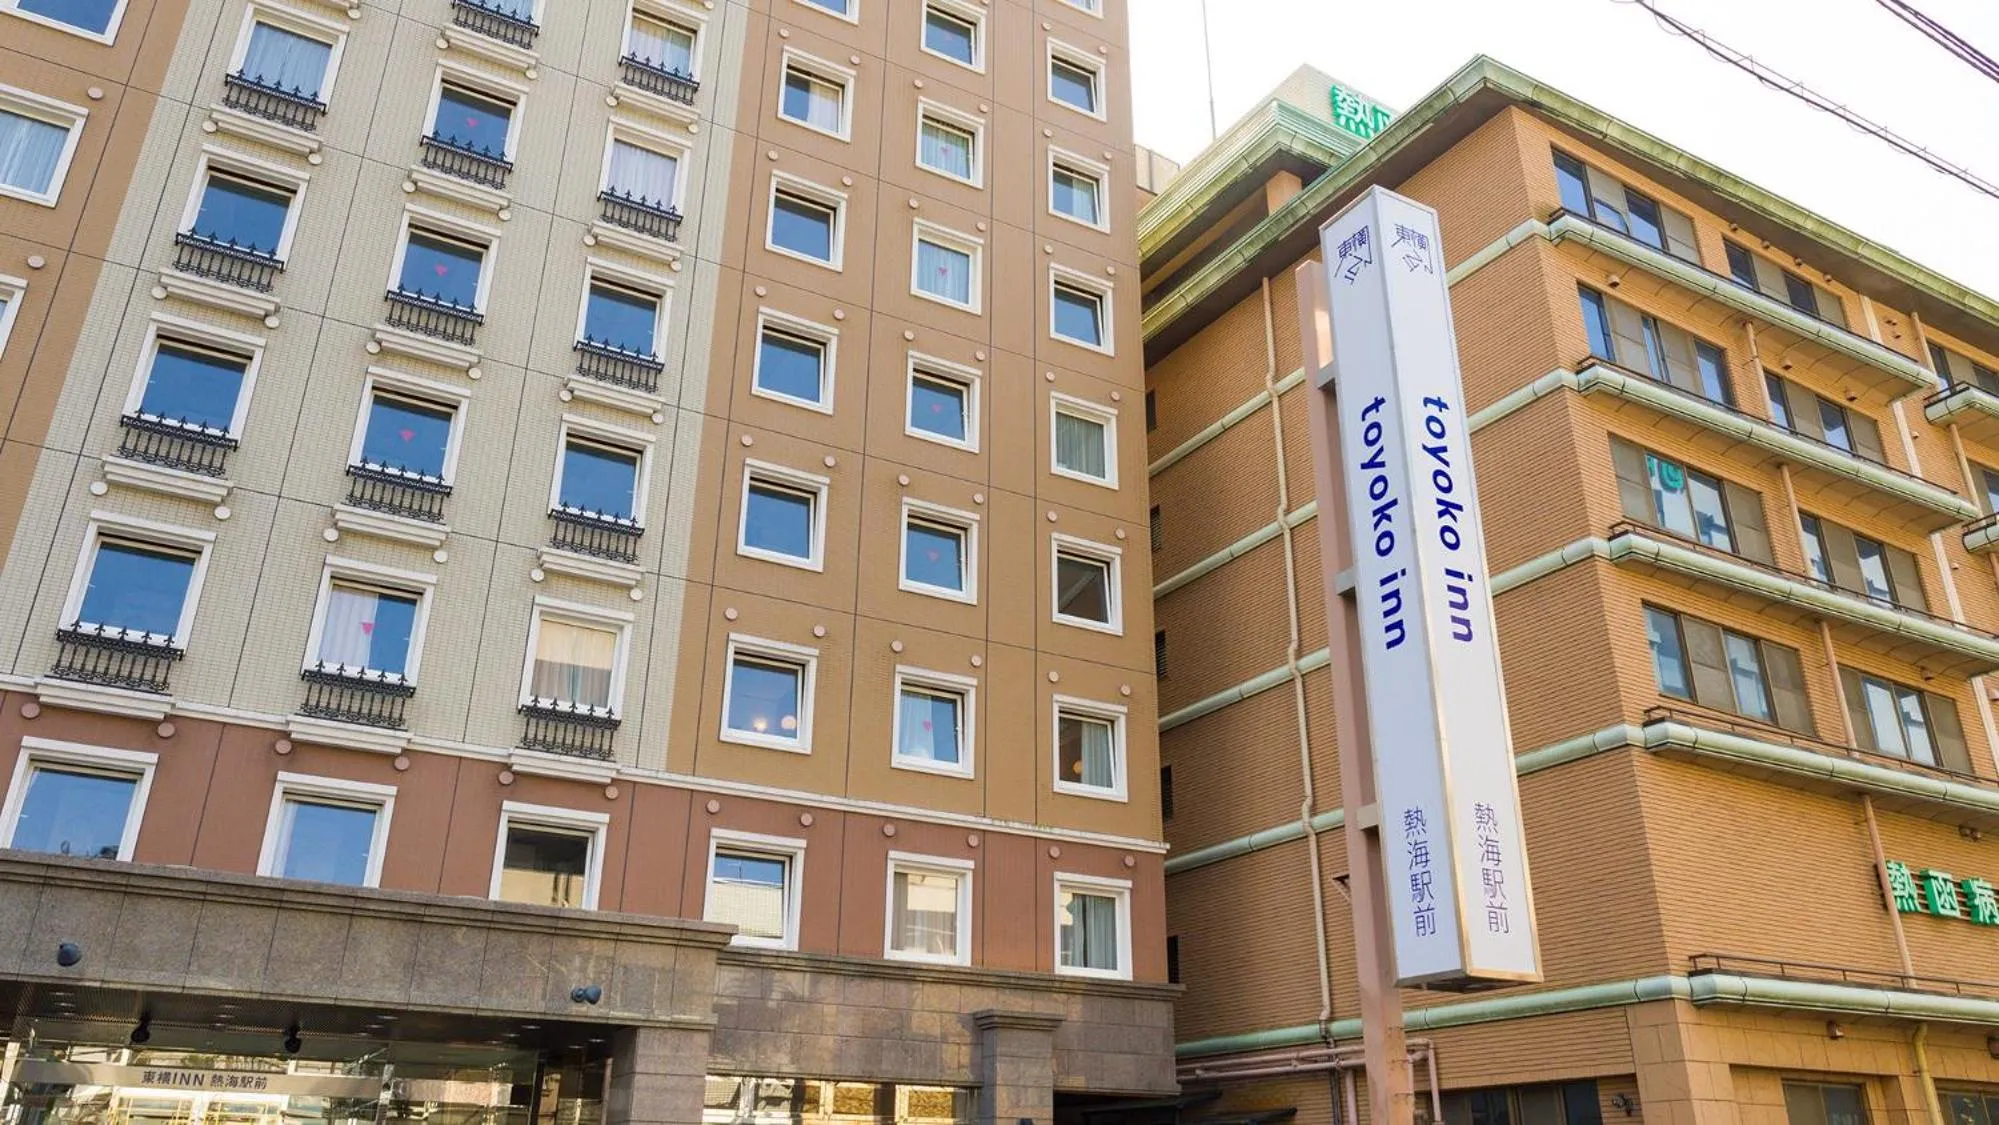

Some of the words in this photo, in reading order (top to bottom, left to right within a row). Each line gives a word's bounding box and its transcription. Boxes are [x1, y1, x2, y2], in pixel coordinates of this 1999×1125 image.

[1361, 395, 1399, 558] toyoko
[1421, 395, 1465, 552] toyoko
[1444, 567, 1474, 643] inn
[1379, 567, 1407, 650] inn
[1403, 804, 1437, 938] 熱海駅前
[1474, 801, 1511, 935] 熱海駅前
